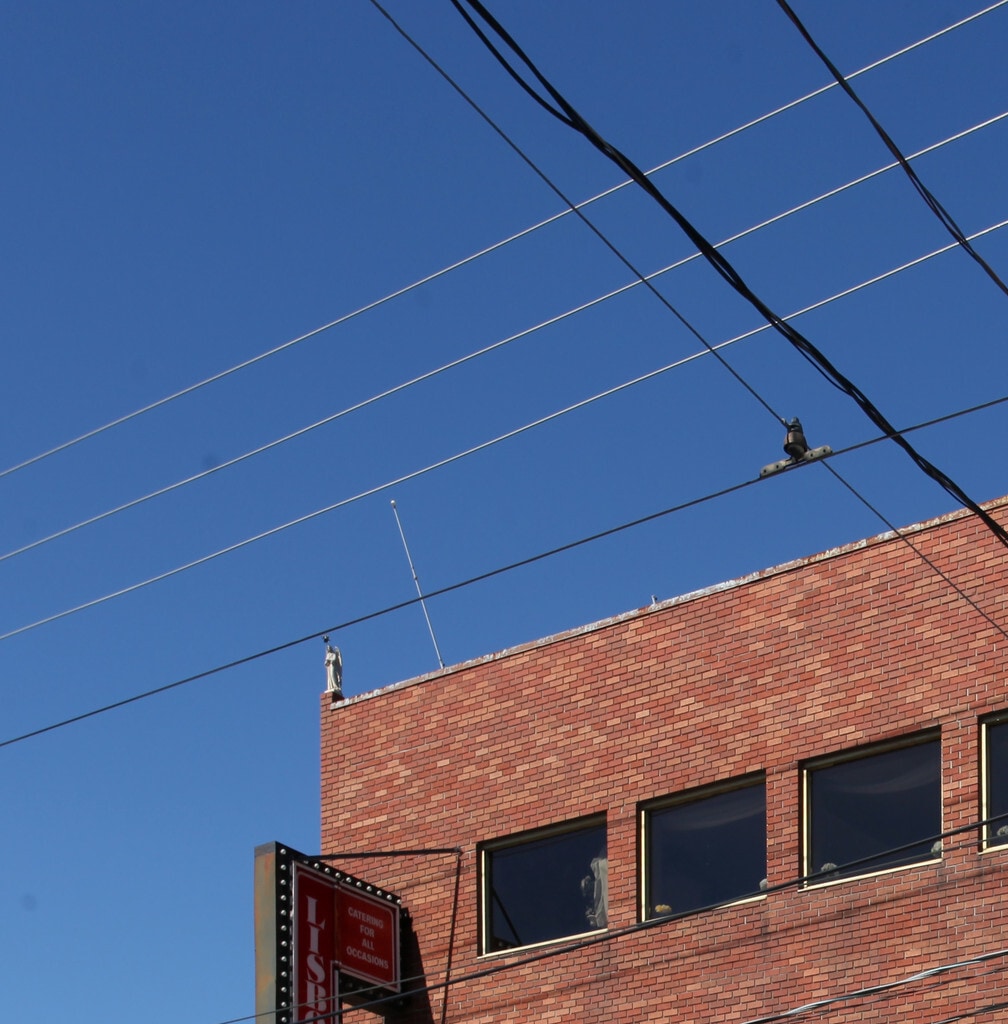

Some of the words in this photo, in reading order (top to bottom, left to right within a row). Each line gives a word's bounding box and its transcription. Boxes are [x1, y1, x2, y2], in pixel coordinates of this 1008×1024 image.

[348, 906, 384, 929] CATERING
[360, 924, 375, 938] FOR
[362, 938, 375, 950] ALL
[346, 945, 389, 969] OCCASIONS
